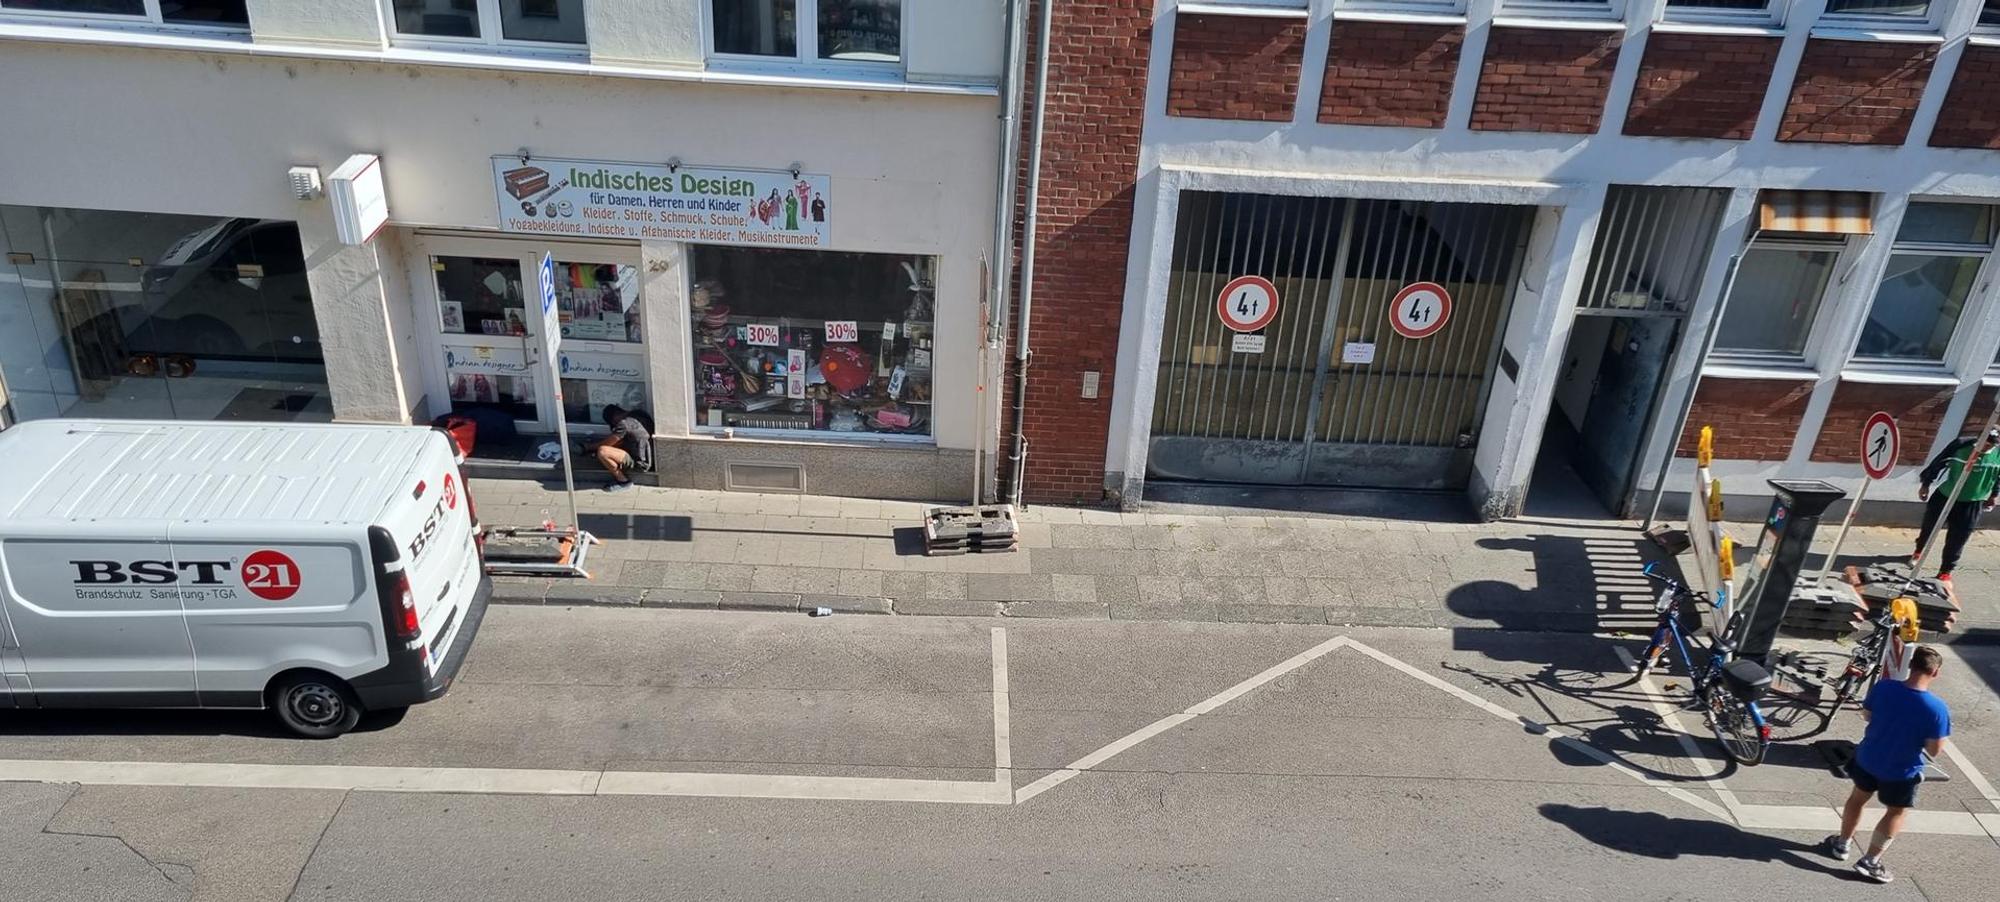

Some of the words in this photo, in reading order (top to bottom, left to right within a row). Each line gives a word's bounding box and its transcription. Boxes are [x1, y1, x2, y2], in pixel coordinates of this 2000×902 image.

[570, 168, 673, 193] Indisches
[681, 174, 755, 197] Design
[590, 192, 605, 205] für
[649, 195, 686, 209] Herren
[687, 198, 706, 210] und
[708, 198, 742, 212] Kinder
[588, 223, 625, 236] Indische
[628, 228, 638, 237] u.
[641, 226, 696, 240] Afghanische
[738, 231, 819, 246] Musikinstrumente
[749, 327, 778, 343] 30%
[827, 324, 856, 340] 30%
[408, 498, 446, 561] BST
[69, 560, 232, 584] BST
[245, 564, 298, 588] 21
[76, 589, 142, 600] Brandschutz
[150, 589, 205, 601] Sanierung
[212, 589, 238, 599] TGA
